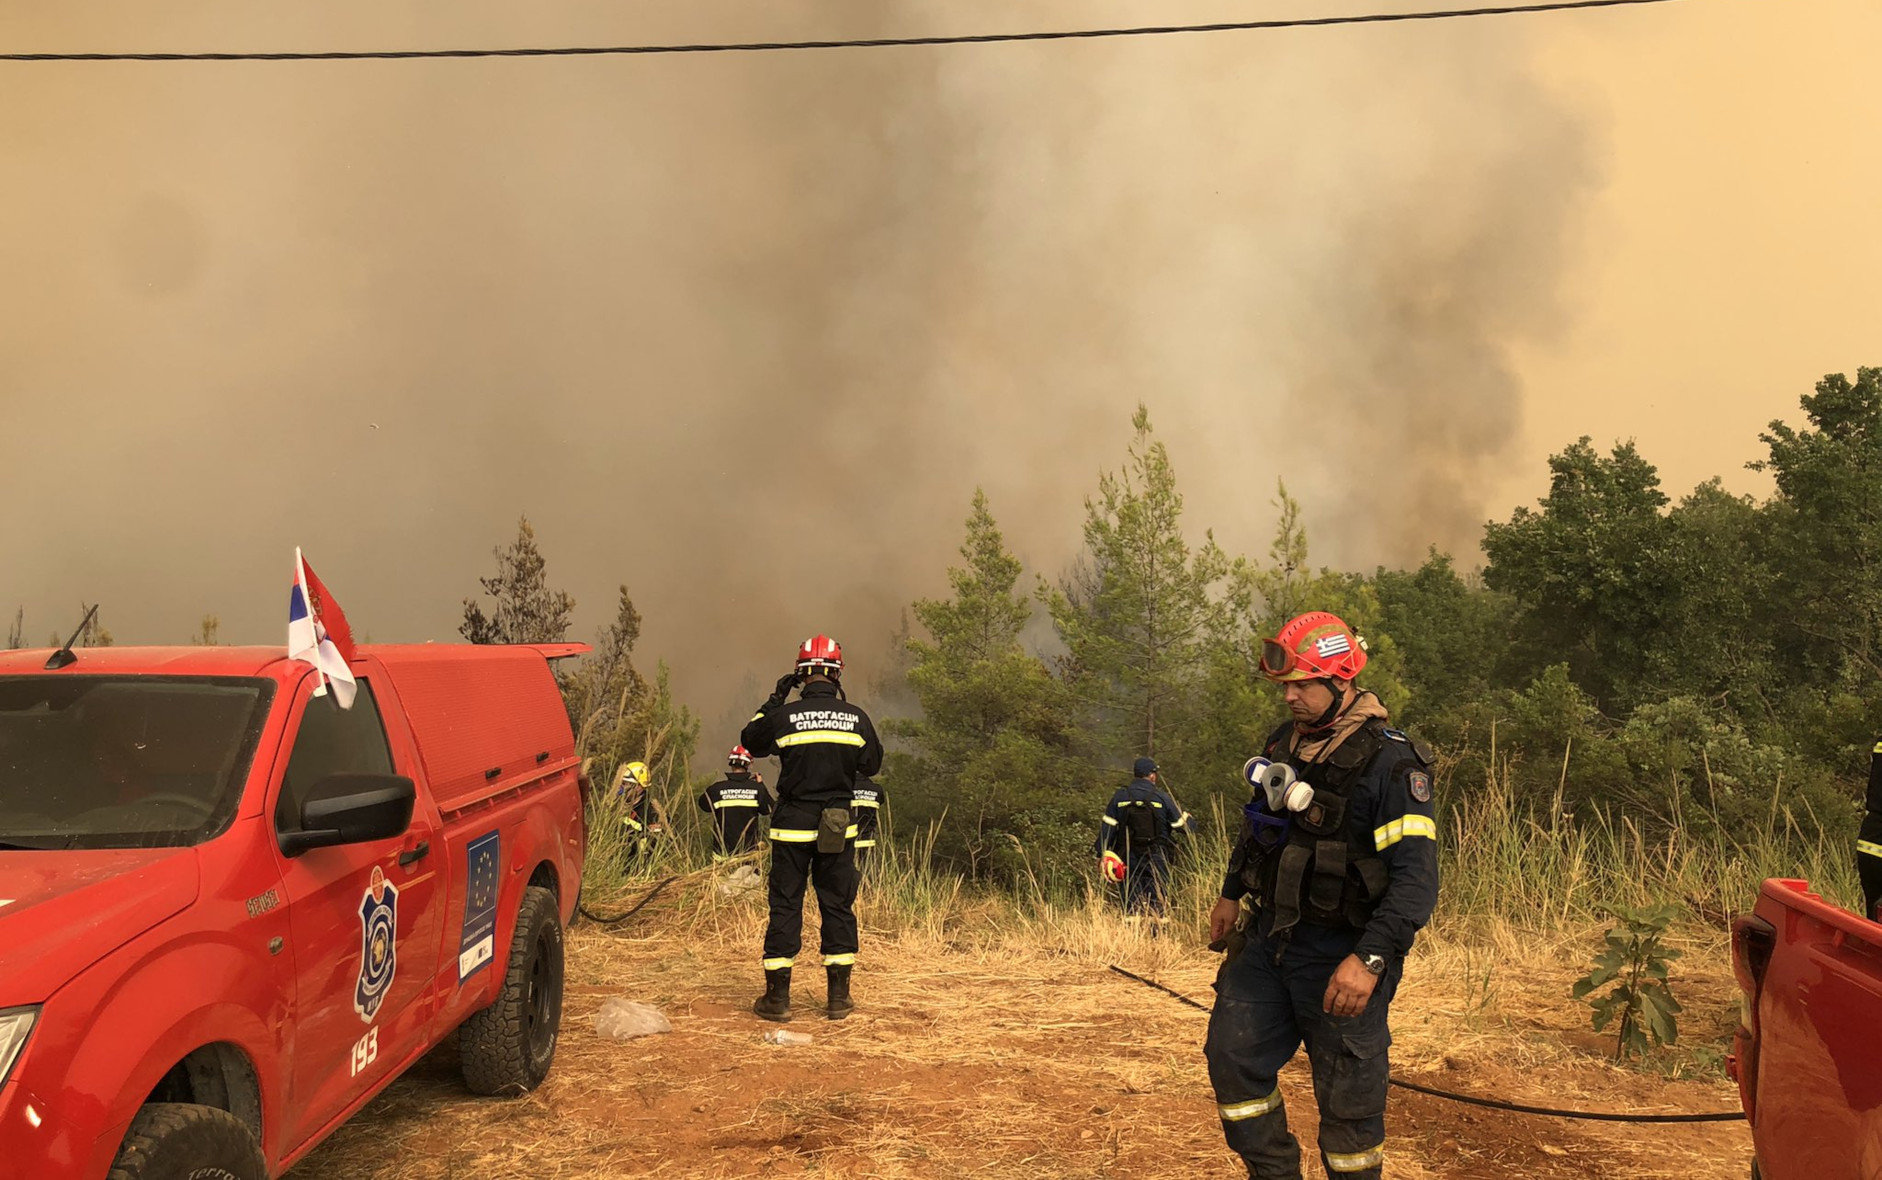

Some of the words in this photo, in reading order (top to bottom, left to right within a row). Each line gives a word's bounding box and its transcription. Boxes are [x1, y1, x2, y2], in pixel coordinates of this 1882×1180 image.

[789, 711, 859, 723] ВАТРОГАСЦИ
[795, 720, 855, 731] СПАСИОЦИ
[351, 1025, 379, 1077] 193
